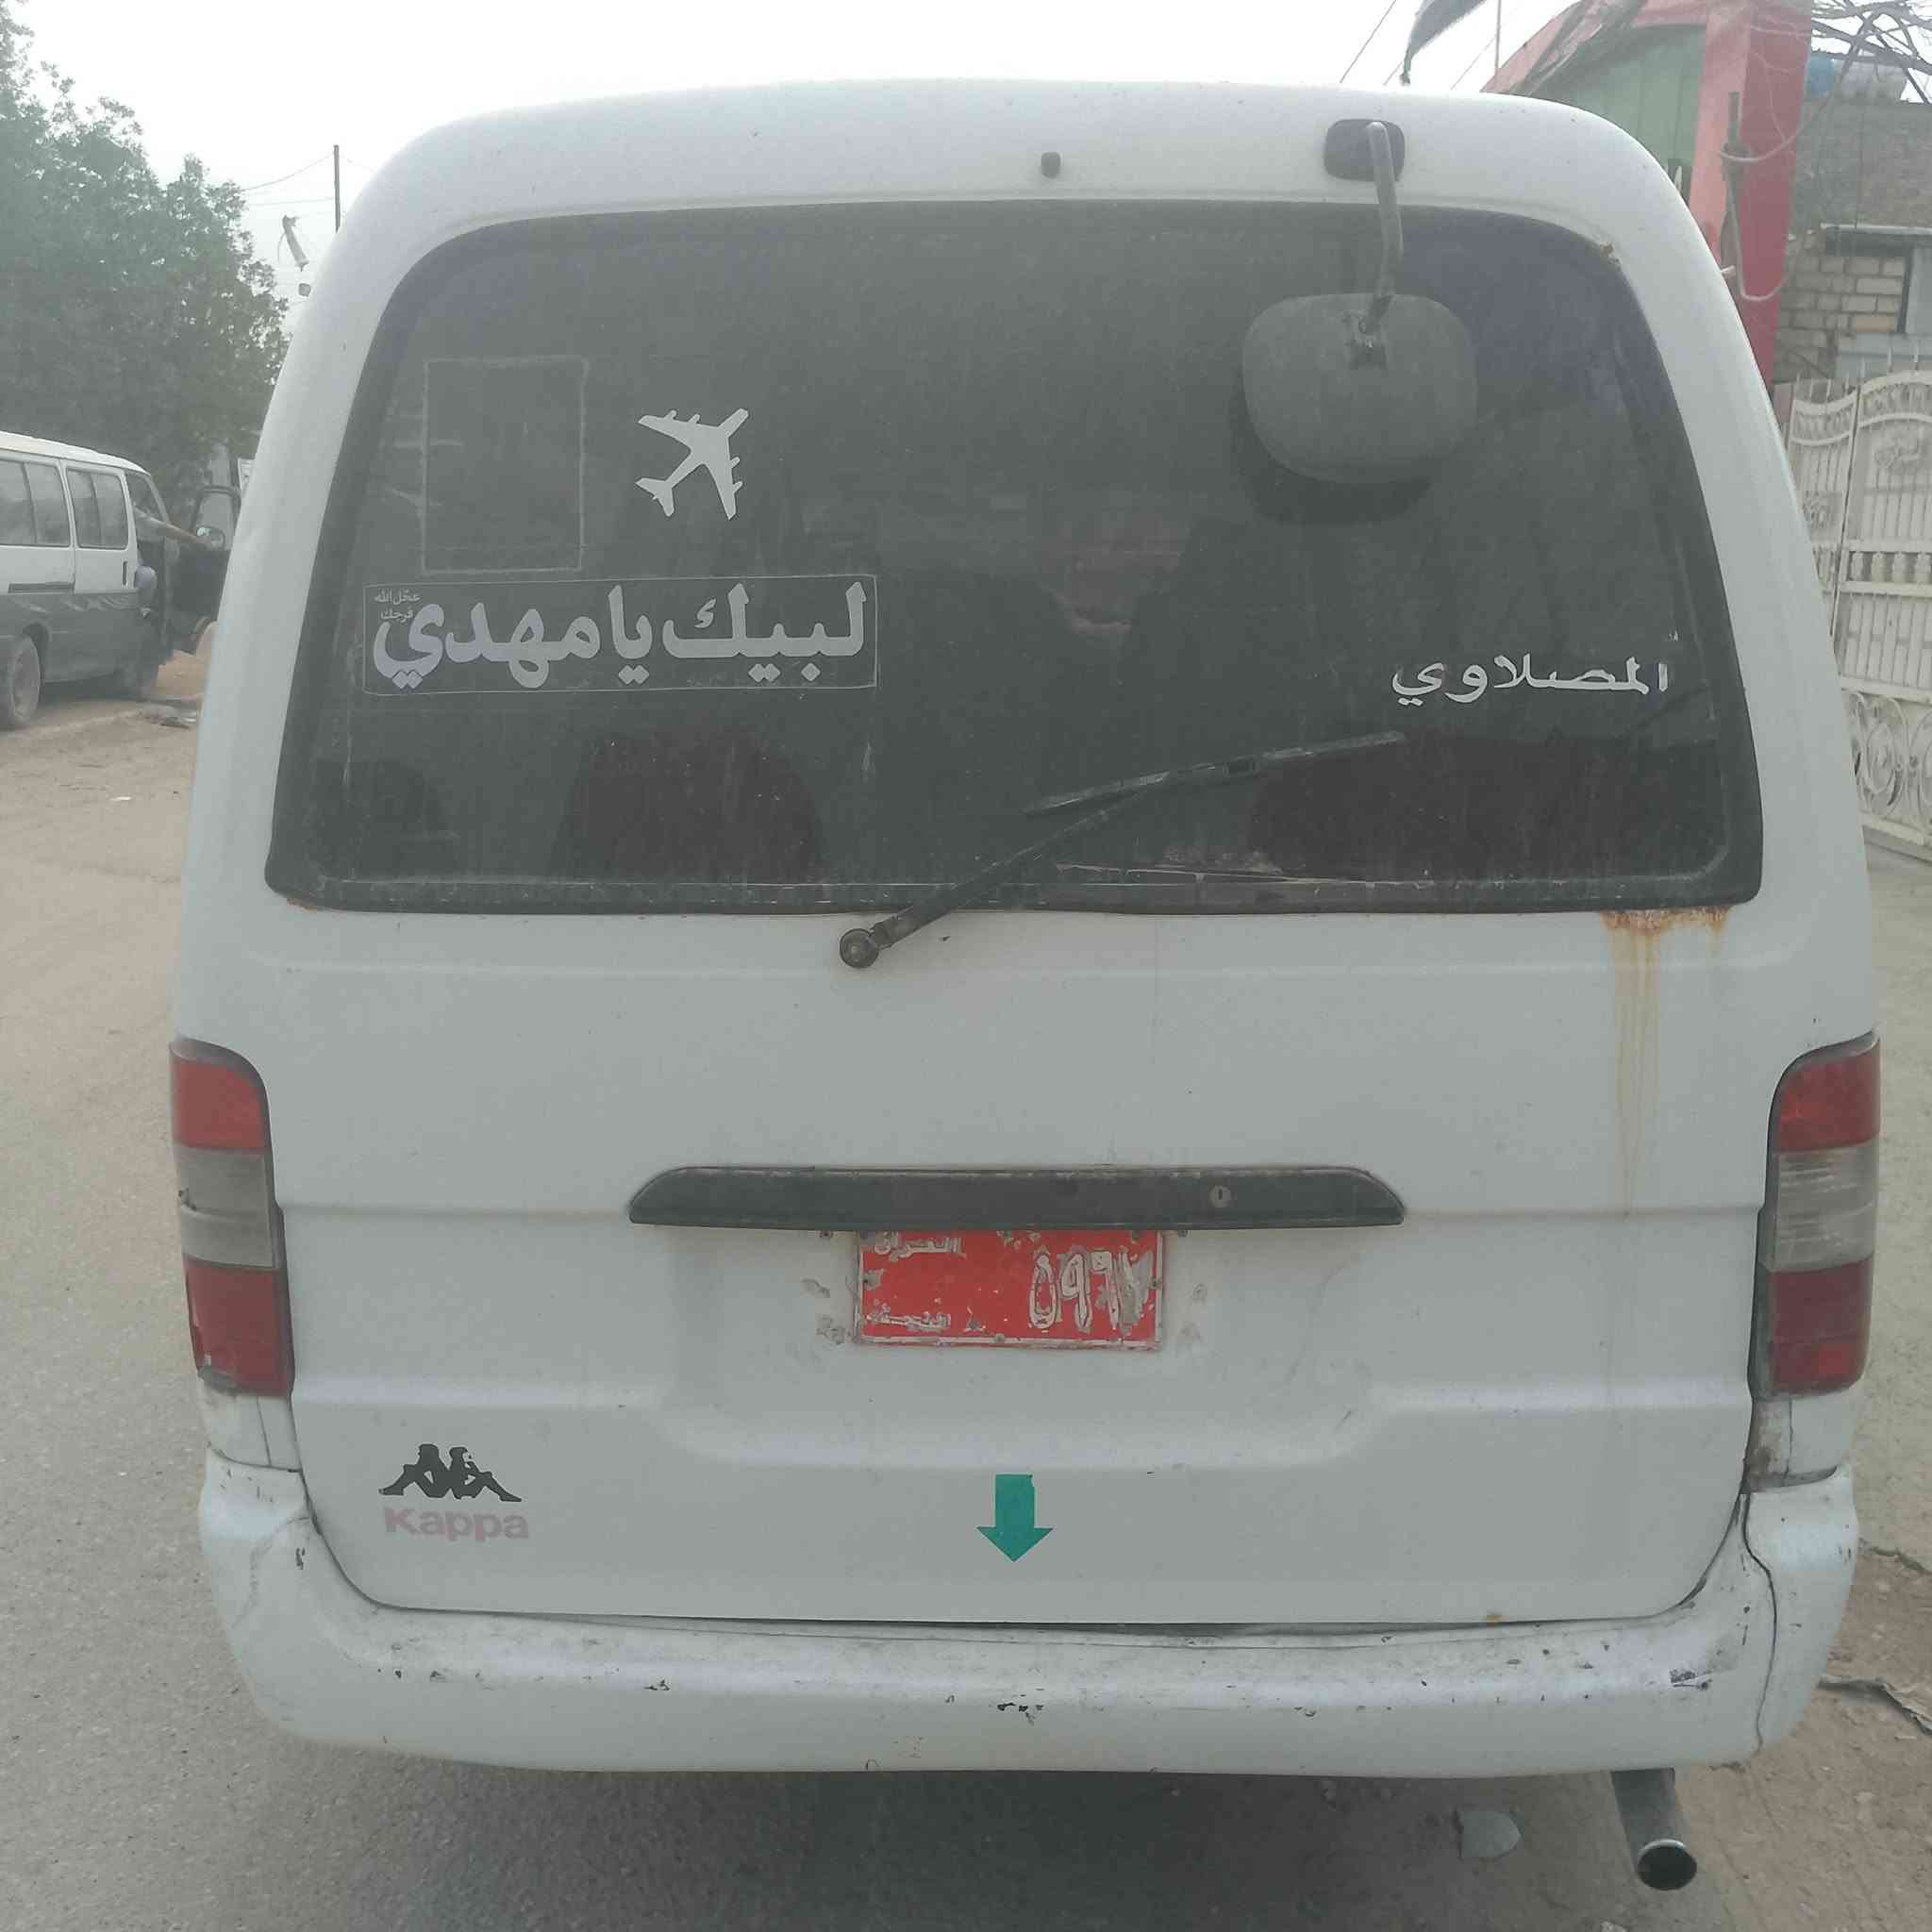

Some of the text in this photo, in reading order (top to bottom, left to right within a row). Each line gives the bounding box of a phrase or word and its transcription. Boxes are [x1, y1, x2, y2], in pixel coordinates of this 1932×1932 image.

[663, 581, 867, 682] لبيك
[1392, 653, 1668, 706] المصلاوي
[384, 1508, 529, 1541] Kappa
